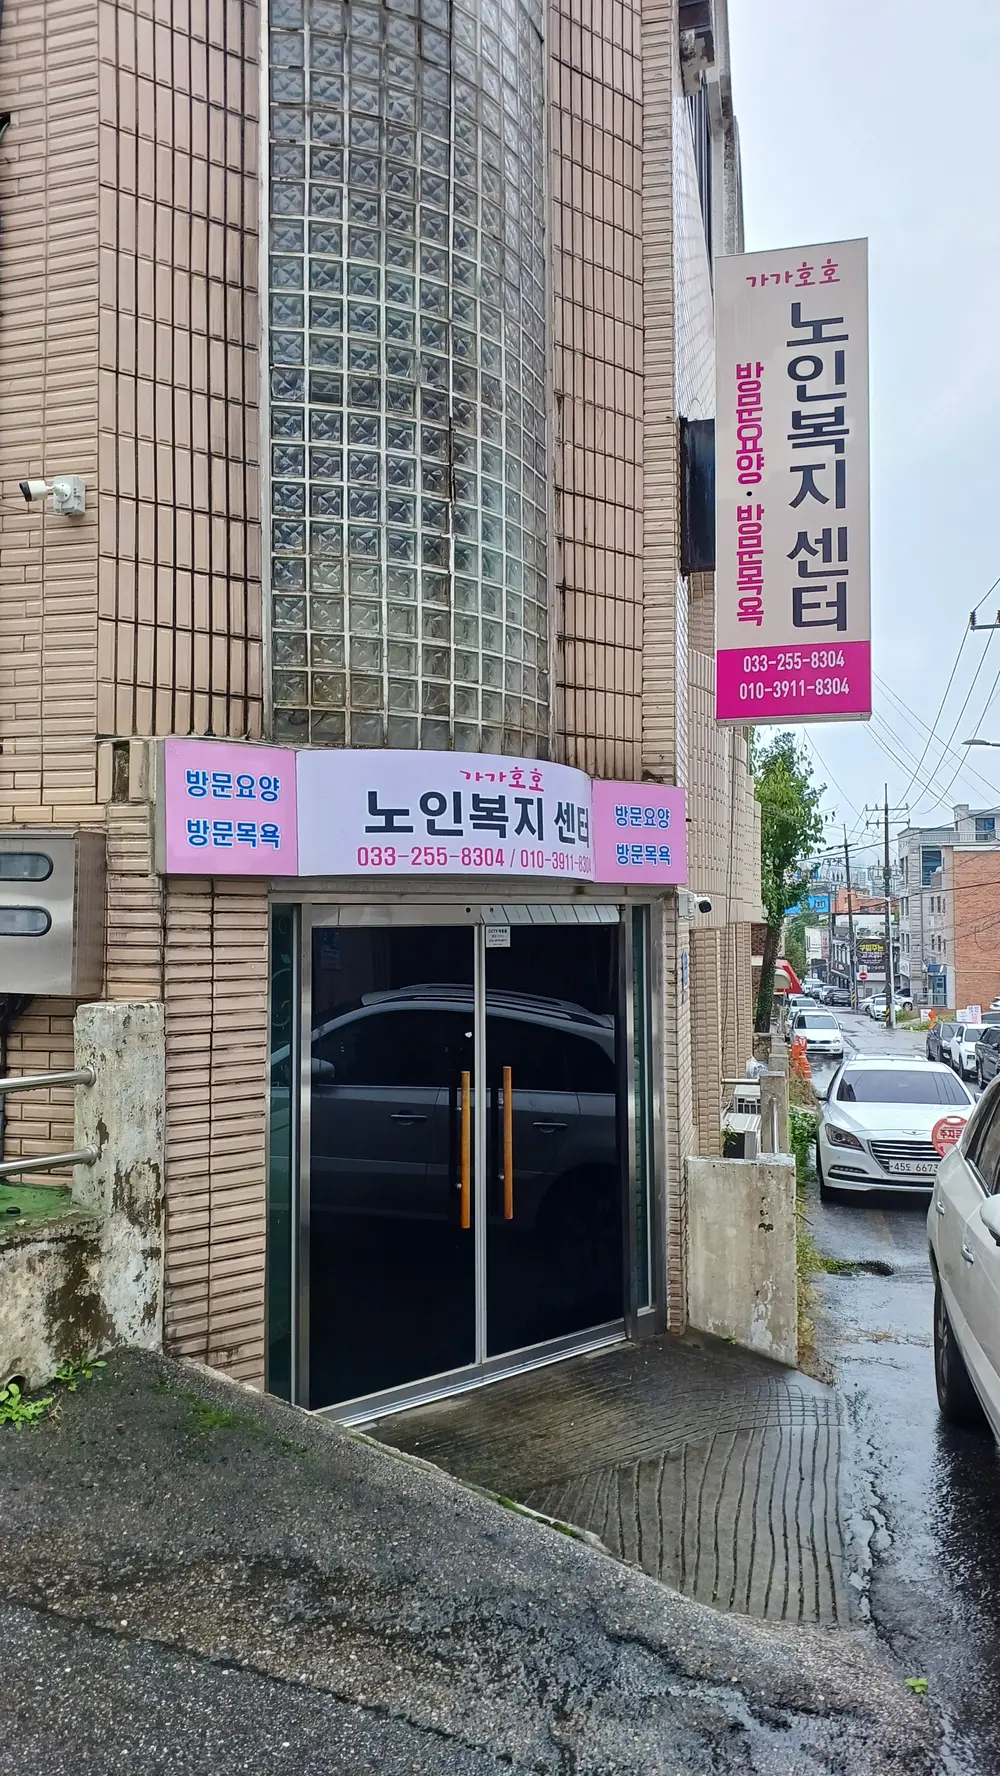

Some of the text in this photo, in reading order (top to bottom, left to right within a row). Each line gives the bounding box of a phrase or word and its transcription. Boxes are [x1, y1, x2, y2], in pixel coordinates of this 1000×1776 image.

[746, 258, 841, 288] 가가호호
[743, 650, 846, 674] 033-255-8304
[739, 677, 850, 700] 010-3911-8304
[185, 769, 281, 803] 방문요양
[459, 766, 545, 793] 가가호호
[615, 805, 670, 829] 방문요양
[187, 818, 281, 850] 방문목욕
[357, 846, 505, 868] 033-255-8304
[616, 843, 671, 866] 방문목욕
